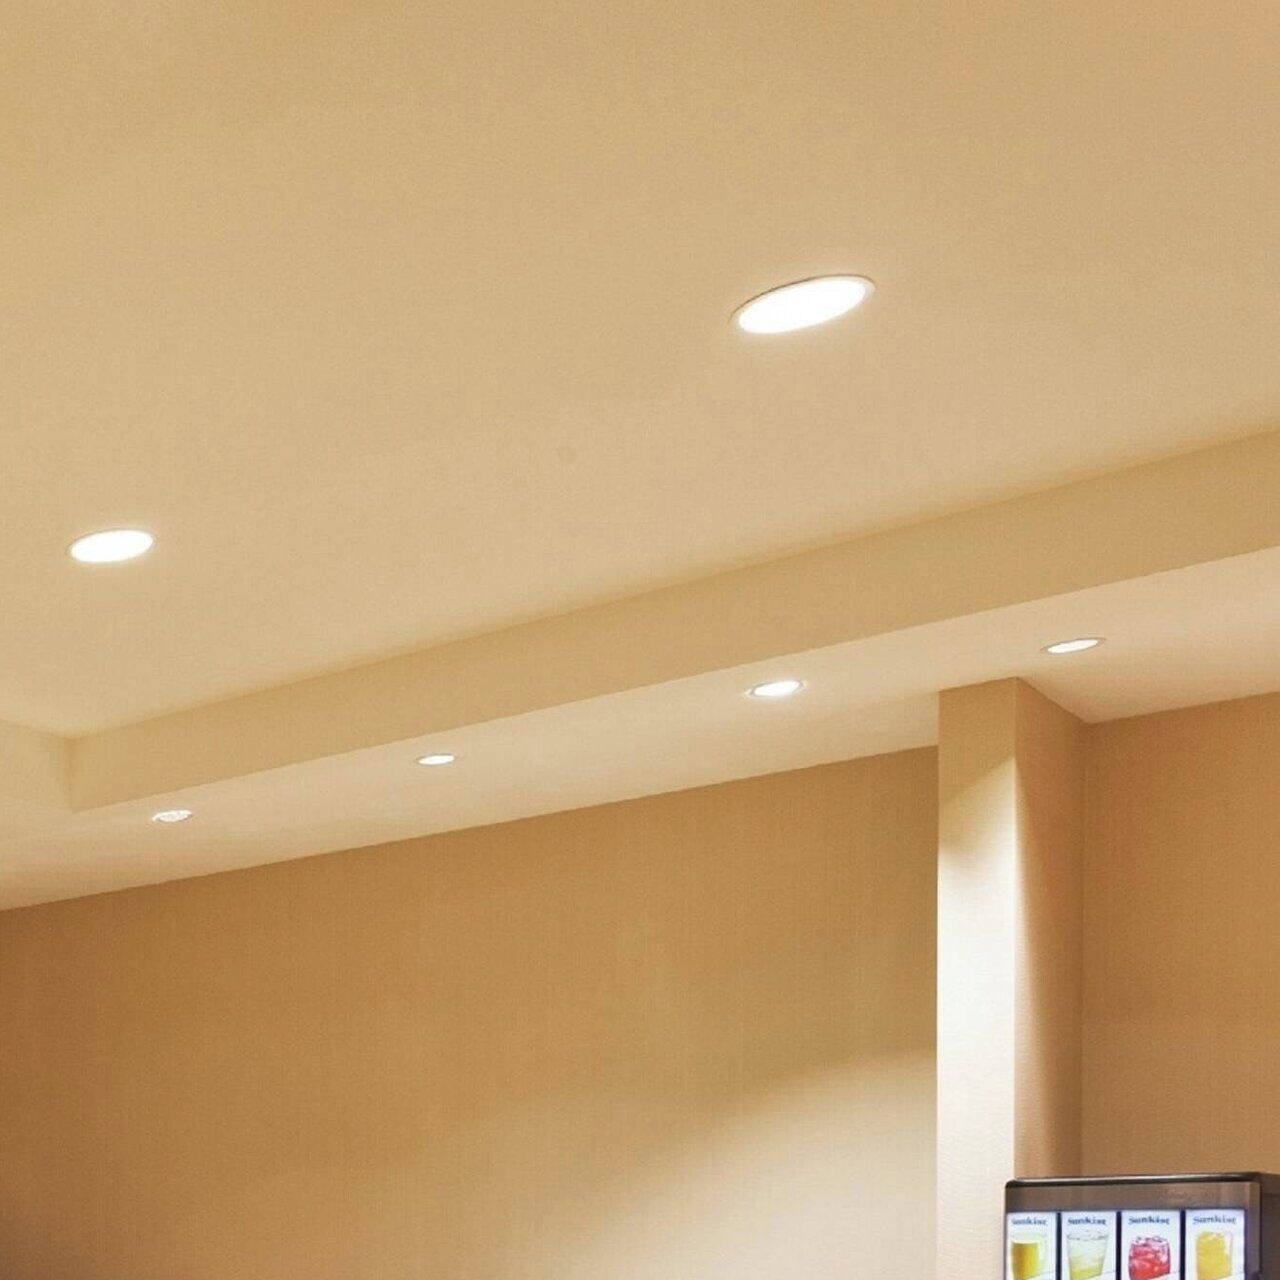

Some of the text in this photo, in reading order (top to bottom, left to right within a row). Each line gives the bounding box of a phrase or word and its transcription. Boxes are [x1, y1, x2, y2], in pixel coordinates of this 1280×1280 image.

[1068, 1216, 1106, 1225] Sunkist
[1128, 1214, 1170, 1225] Sunkist
[1193, 1214, 1236, 1225] Sunkist
